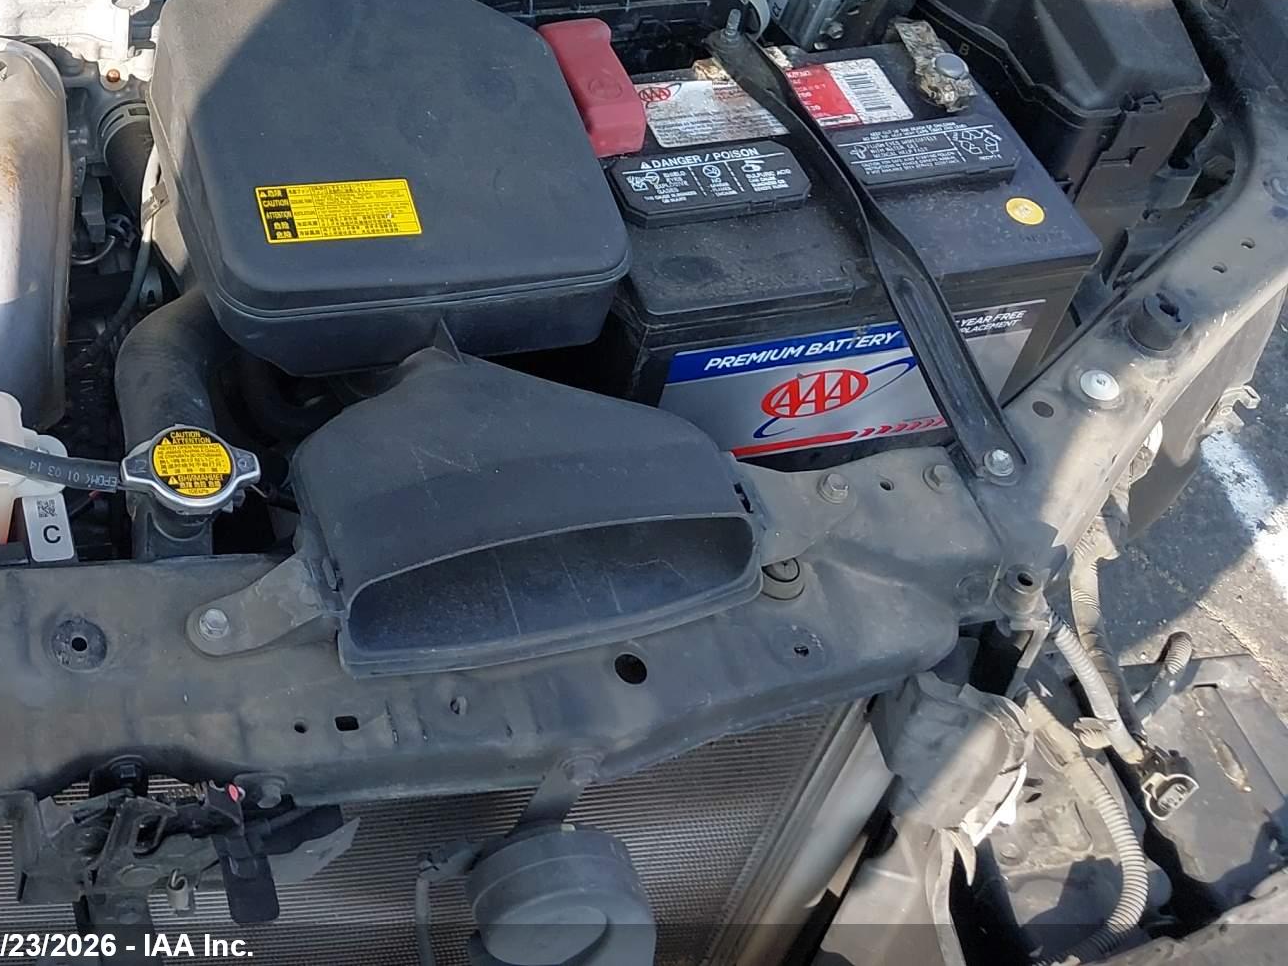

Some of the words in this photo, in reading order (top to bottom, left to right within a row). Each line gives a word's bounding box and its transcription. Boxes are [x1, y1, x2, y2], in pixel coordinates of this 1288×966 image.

[640, 87, 669, 101] AAA
[652, 155, 702, 169] DANGER
[714, 147, 760, 161] POISON
[263, 199, 289, 208] CAUTION
[960, 315, 993, 327] YEAR
[993, 309, 1028, 322] FREE
[704, 344, 807, 371] PREMIUM
[805, 330, 901, 357] BATTERY
[765, 369, 865, 418] AAA
[170, 431, 202, 439] CAUTION
[172, 436, 212, 445] ATTENTION
[43, 525, 61, 544] C
